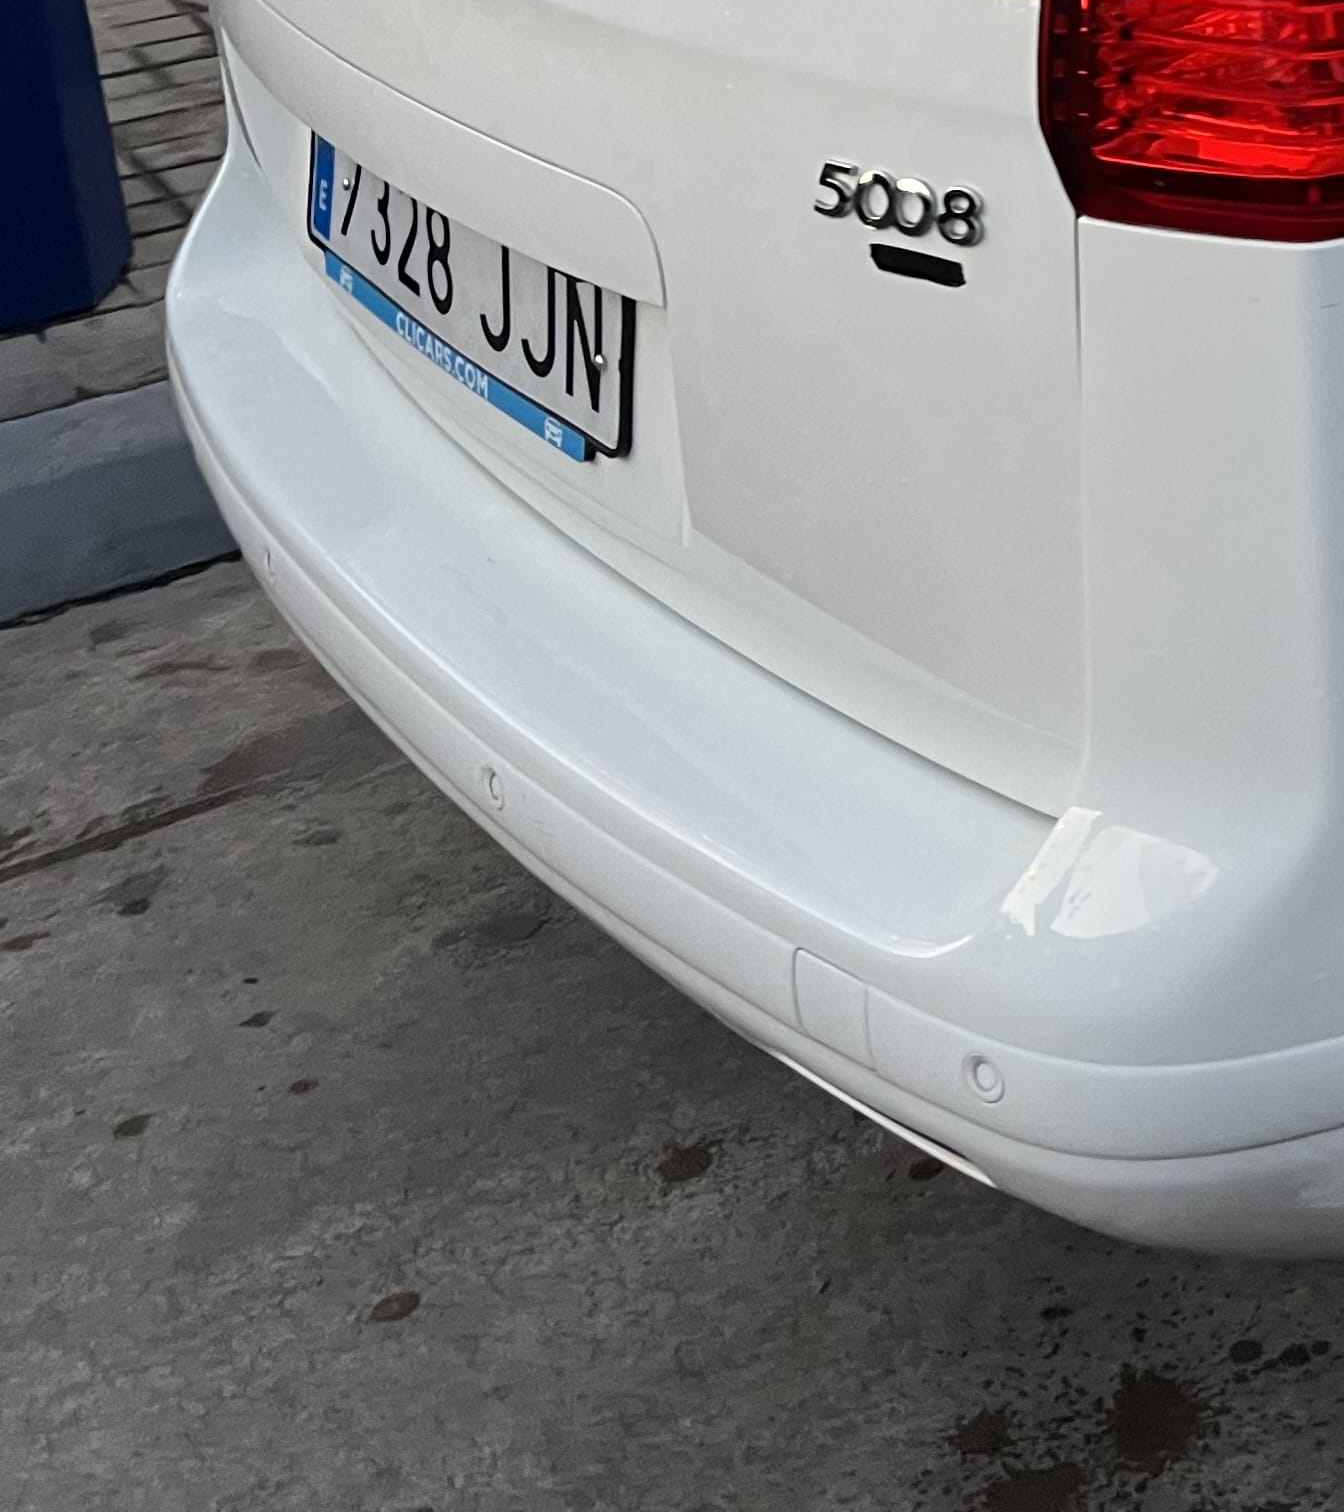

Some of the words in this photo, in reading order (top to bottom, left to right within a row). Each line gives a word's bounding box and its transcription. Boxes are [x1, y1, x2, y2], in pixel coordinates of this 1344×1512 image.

[814, 159, 985, 248] 5008
[395, 311, 489, 399] CLICARS.COM
[479, 244, 603, 414] JJN
